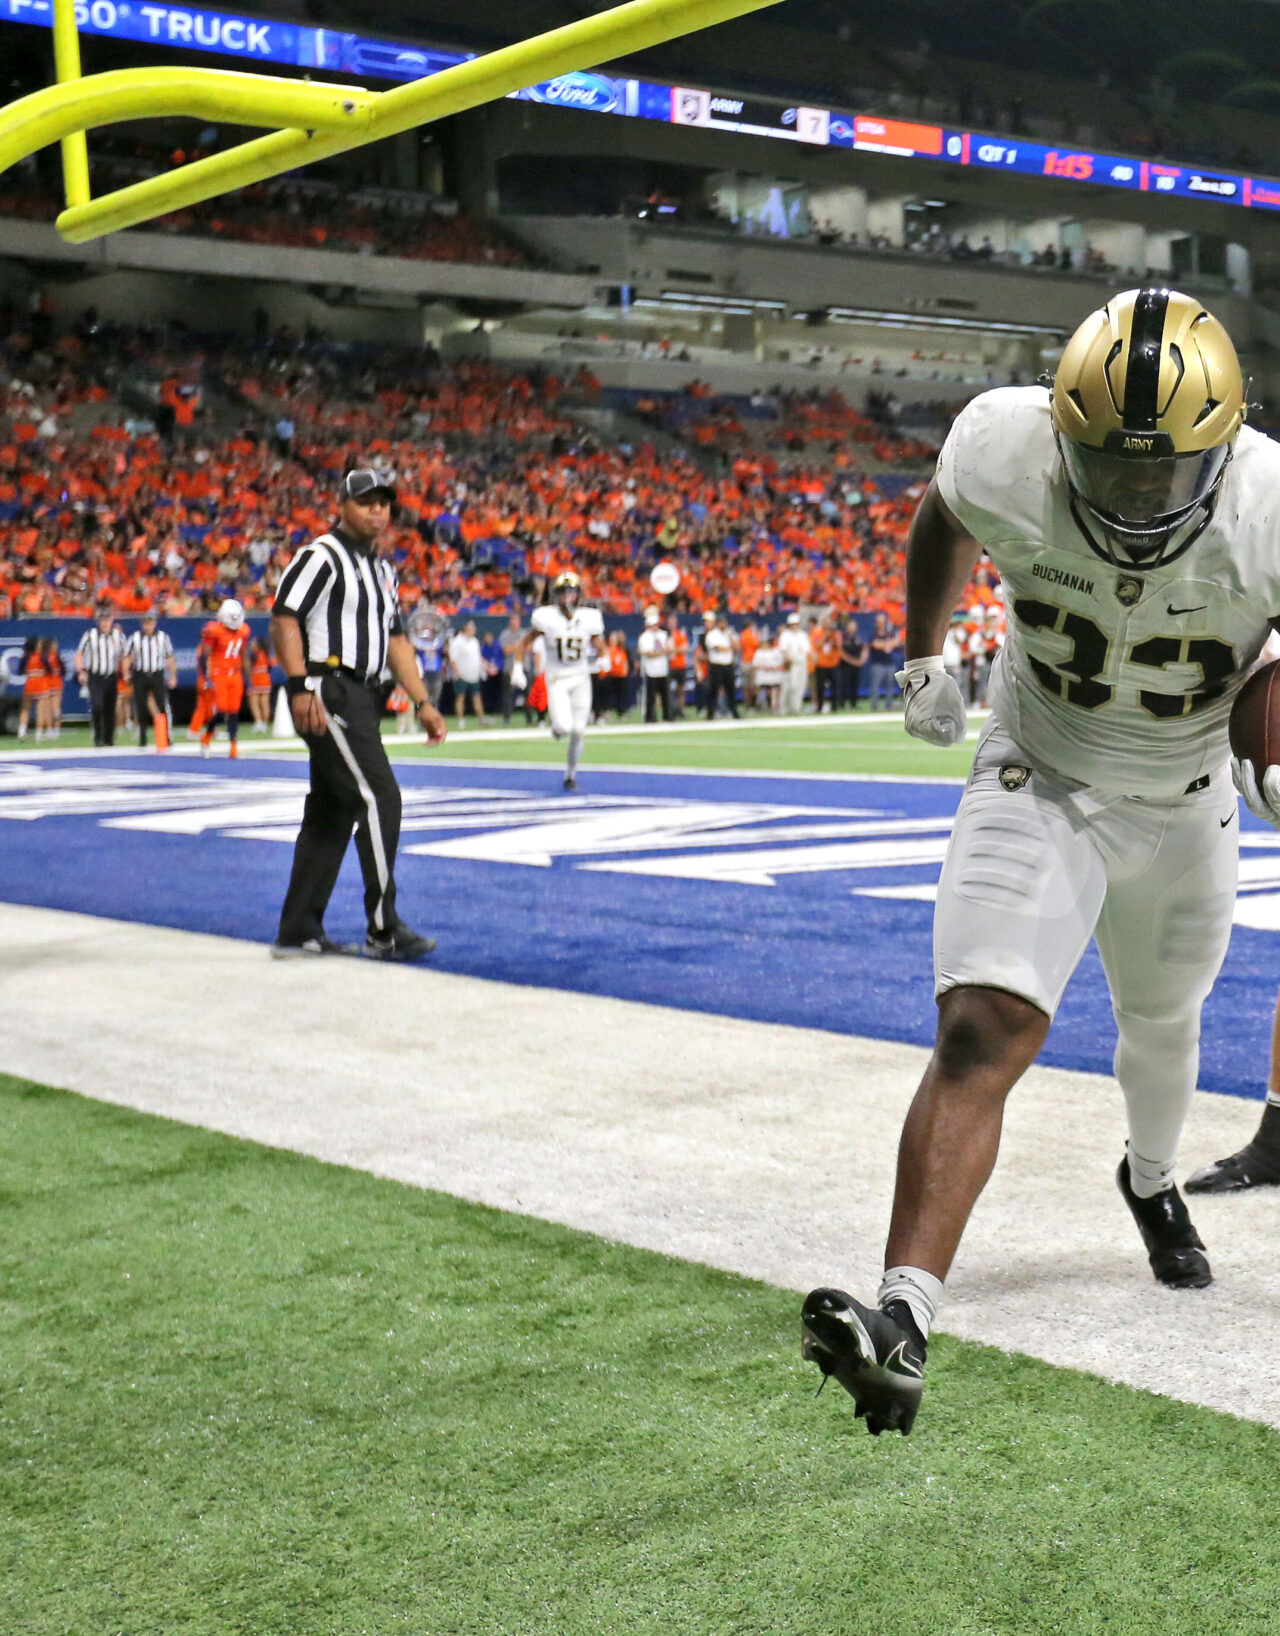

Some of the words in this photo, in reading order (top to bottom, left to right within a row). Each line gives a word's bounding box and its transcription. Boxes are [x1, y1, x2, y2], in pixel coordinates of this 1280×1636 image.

[141, 6, 271, 54] TRUCK
[545, 78, 599, 105] Ford
[809, 116, 824, 135] 7
[1043, 152, 1094, 179] 1:15
[1123, 437, 1154, 451] ARMY
[1031, 562, 1095, 596] BUCHANAN
[555, 636, 582, 663] 15
[1012, 596, 1236, 722] 33
